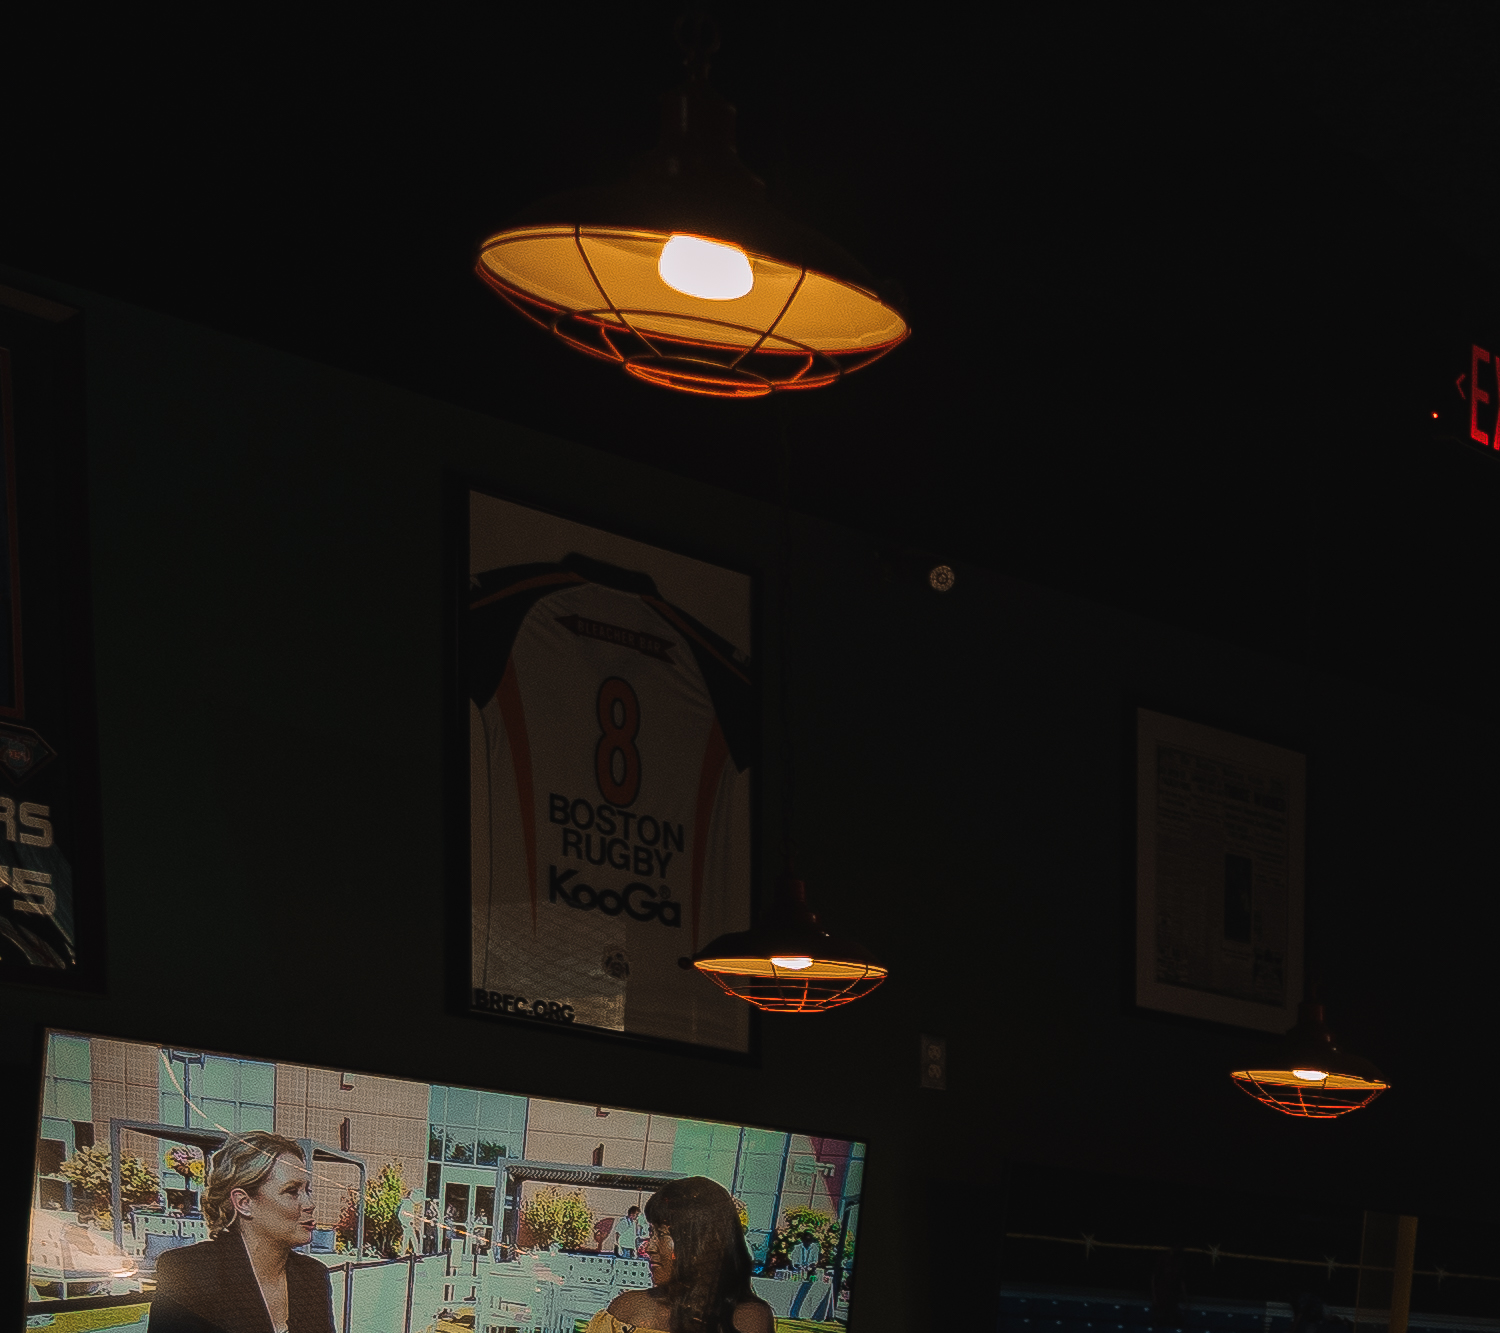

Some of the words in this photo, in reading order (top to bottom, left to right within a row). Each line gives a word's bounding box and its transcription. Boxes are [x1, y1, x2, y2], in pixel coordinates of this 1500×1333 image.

[577, 620, 635, 646] BLEACHER
[639, 637, 661, 653] BAR
[595, 676, 642, 809] 8
[549, 792, 684, 854] BOSTON
[562, 826, 673, 880] RUGBY
[475, 988, 575, 1023] BRFC.ORG
